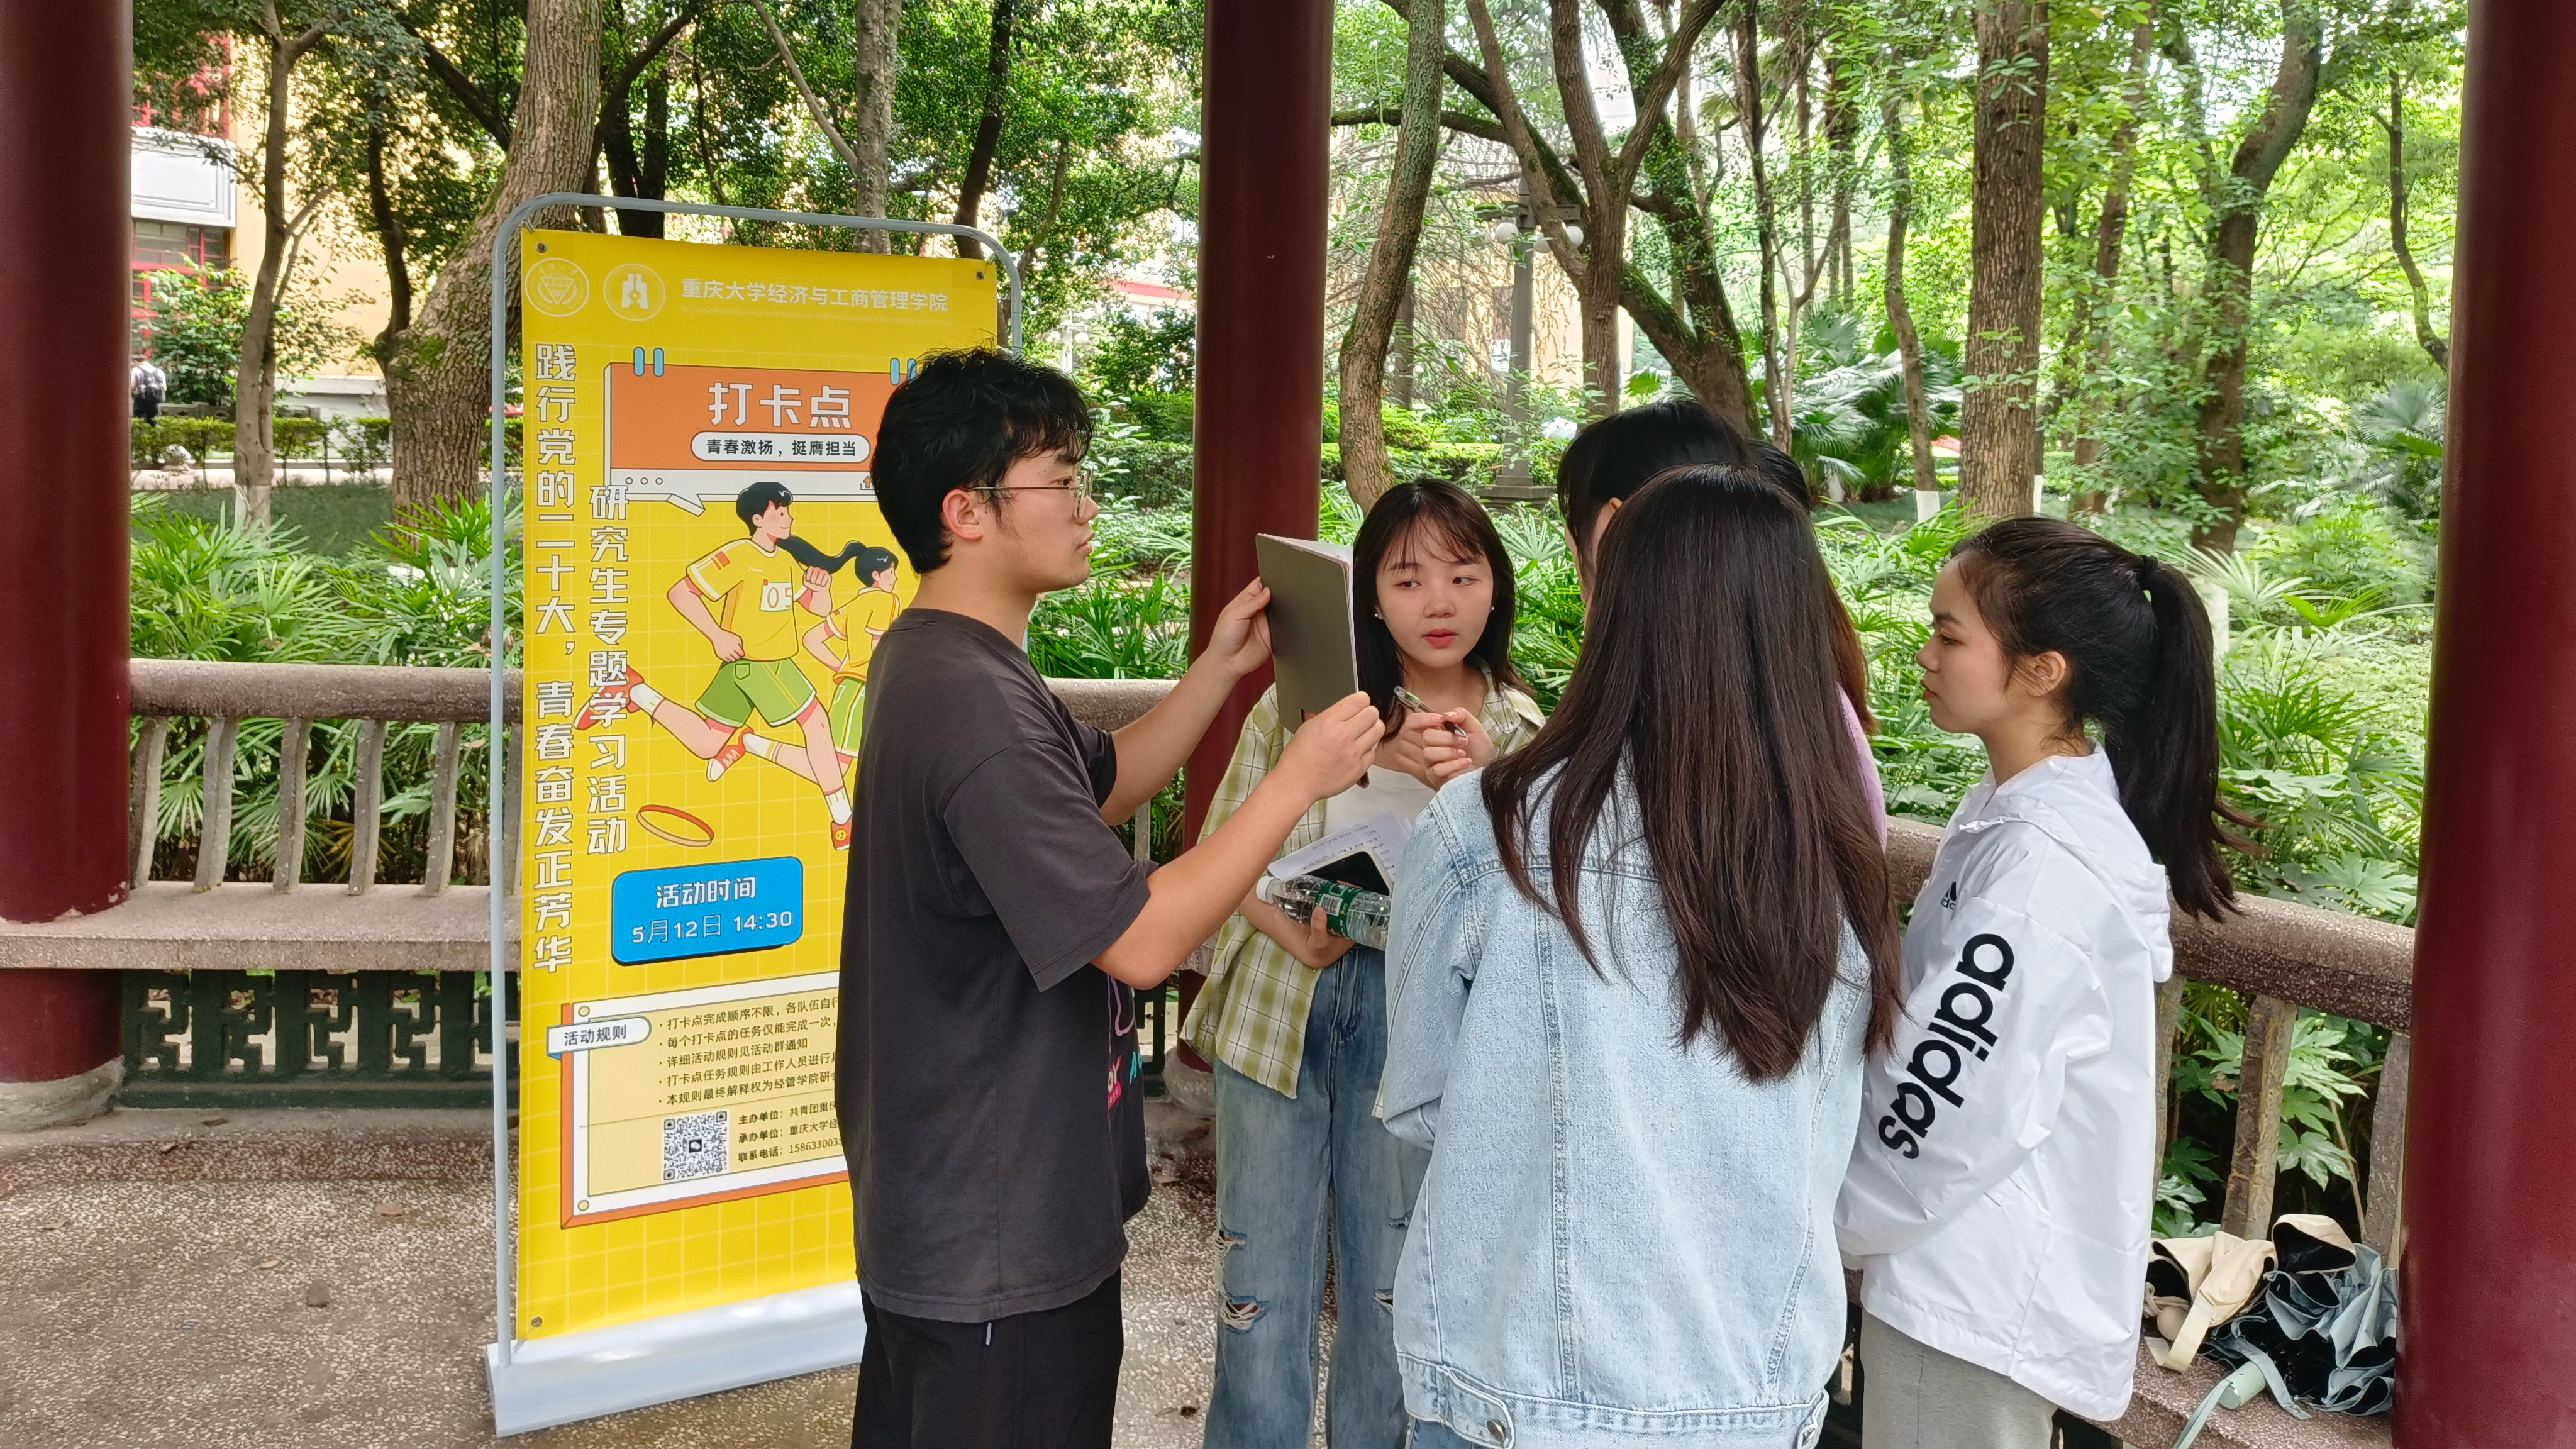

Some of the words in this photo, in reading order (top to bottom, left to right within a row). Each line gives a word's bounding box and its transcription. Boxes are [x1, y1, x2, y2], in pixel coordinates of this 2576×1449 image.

[680, 277, 948, 312] 重庆大学经济与工商管理学院
[708, 381, 852, 429] 打卡点
[767, 587, 792, 609] 05
[587, 485, 630, 855] 研究生专题学习活动
[655, 875, 757, 909] 活动时间
[631, 914, 721, 945] 5月12日
[733, 911, 794, 933] 14:30
[564, 1024, 626, 1046] 活动规则
[1877, 933, 2014, 1160] adidas
[667, 1038, 808, 1067] 详细活动规则见活动群通知
